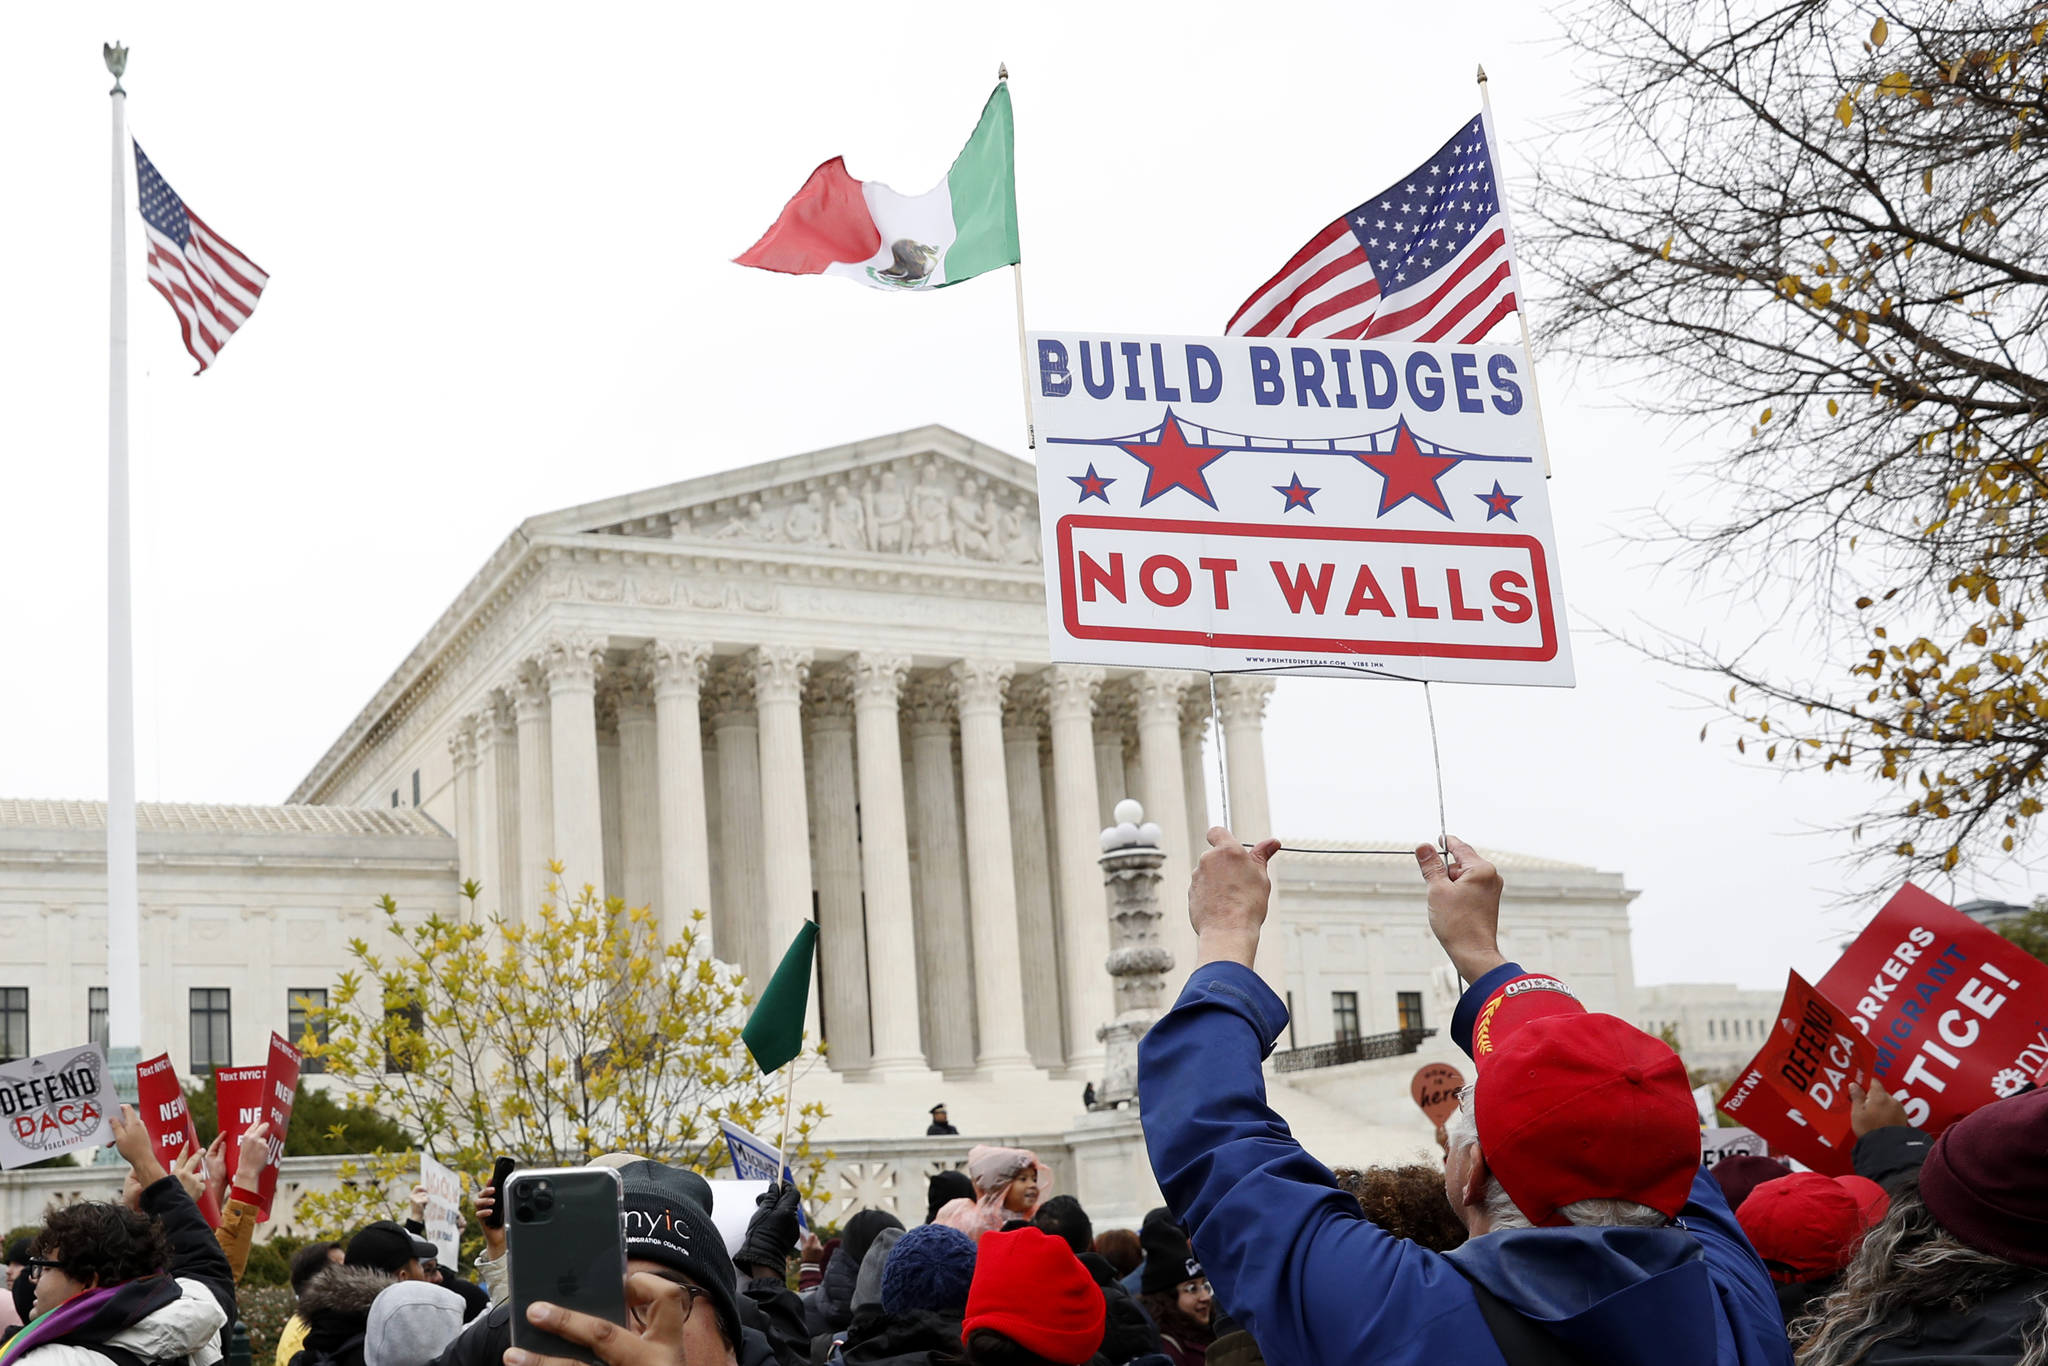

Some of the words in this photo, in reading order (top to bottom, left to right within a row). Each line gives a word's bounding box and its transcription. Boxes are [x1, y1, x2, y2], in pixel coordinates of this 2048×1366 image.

[1037, 339, 1223, 404] BUILD
[1249, 346, 1524, 416] BRIDGES
[1078, 550, 1238, 611] NOT
[1269, 561, 1534, 625] WALLS
[1780, 1000, 1833, 1093] DEFEND
[1892, 962, 2021, 1129] STICE!
[0, 1068, 97, 1116] DEFEND
[219, 1071, 238, 1082] Text
[239, 1070, 261, 1081] NYIC
[1723, 1086, 1750, 1112] Text
[1744, 1068, 1764, 1091] NY
[1809, 1032, 1855, 1111] DACA
[15, 1101, 100, 1139] DACA
[162, 1130, 184, 1148] FOR
[624, 1208, 691, 1240] nyic
[663, 1240, 690, 1257] COALITION
